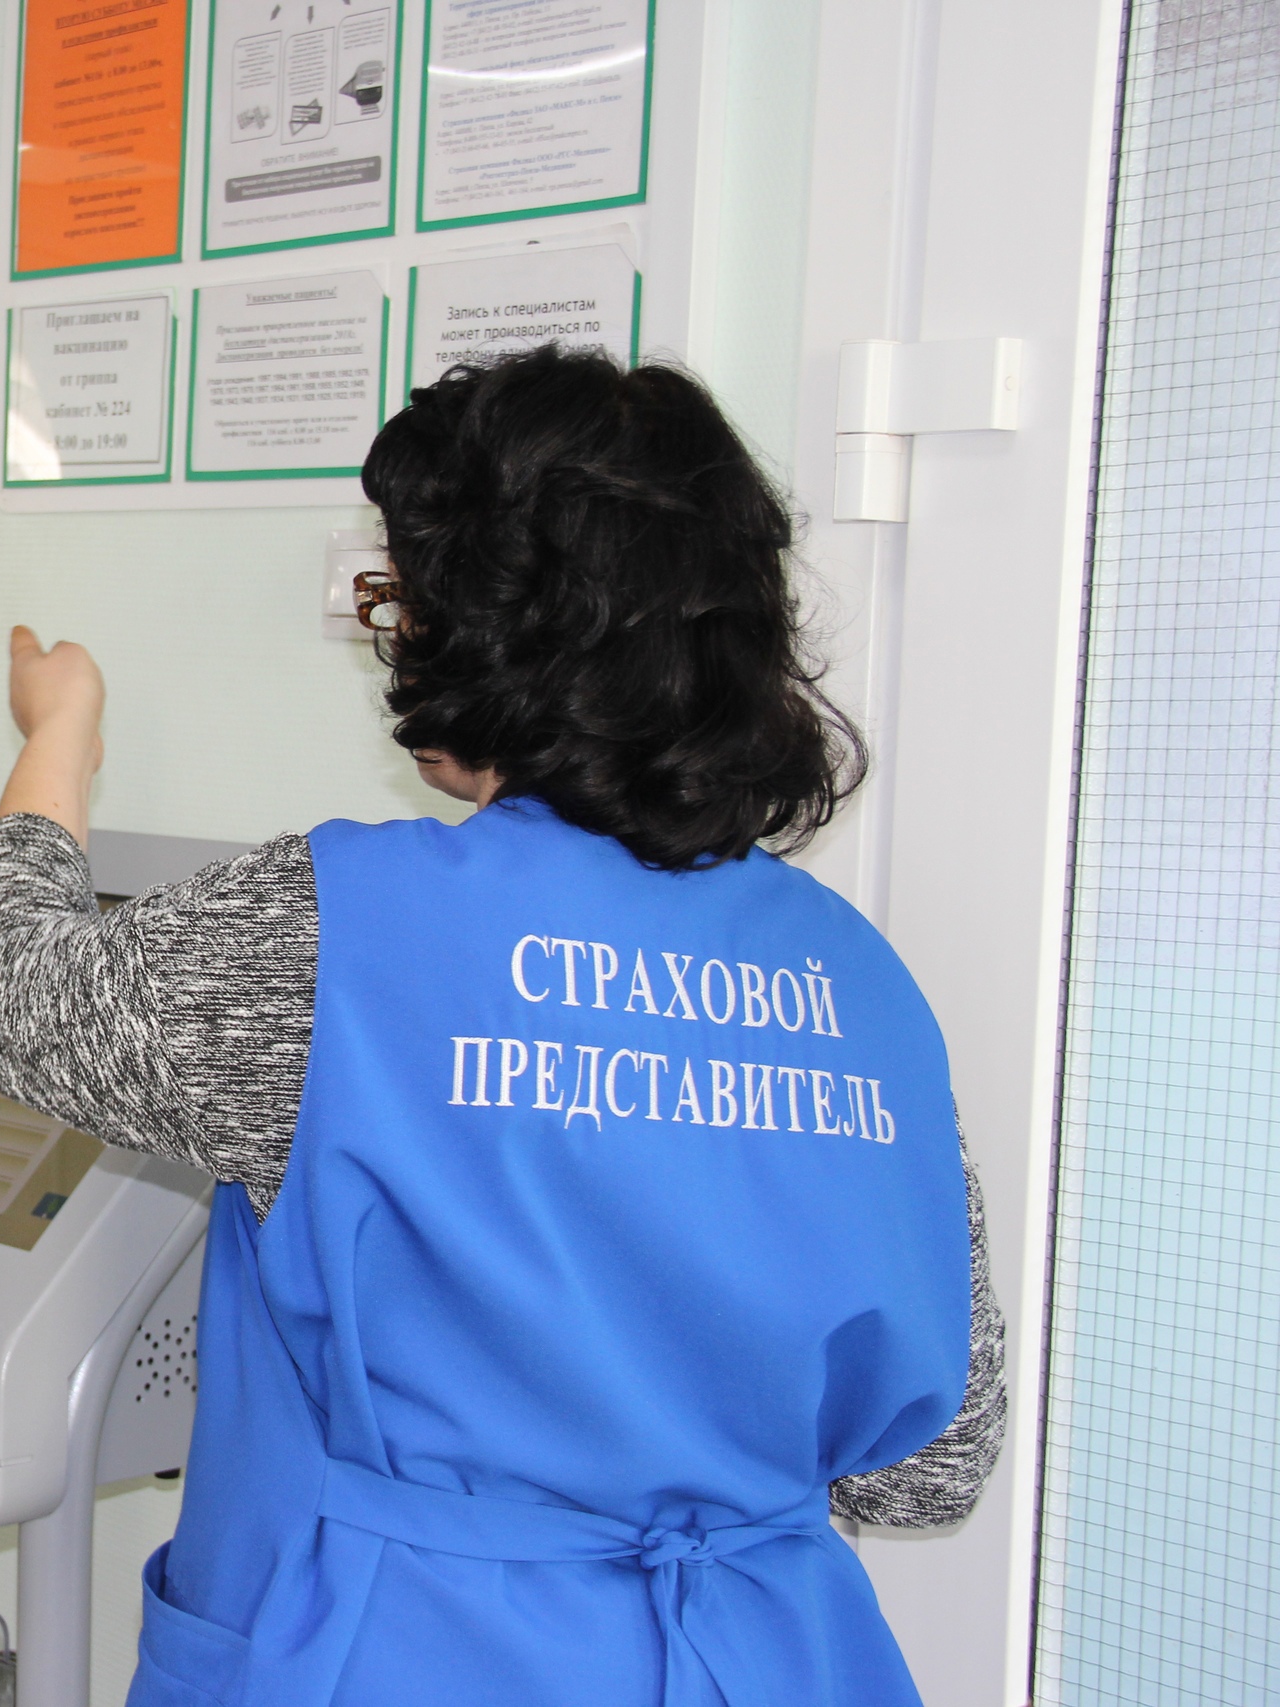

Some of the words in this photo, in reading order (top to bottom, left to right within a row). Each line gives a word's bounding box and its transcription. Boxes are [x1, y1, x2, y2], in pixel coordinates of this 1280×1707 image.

[446, 306, 489, 321] Запись
[493, 306, 501, 317] к
[504, 299, 596, 319] специалистам
[46, 311, 122, 331] Приглашаем
[125, 310, 140, 321] на
[440, 328, 480, 341] может
[484, 321, 579, 340] производиться
[584, 320, 600, 333] по
[54, 339, 129, 355] вакцинацию
[435, 349, 495, 364] телефону
[60, 375, 72, 387] от
[76, 373, 118, 390] гриппа
[45, 403, 92, 419] кабинет
[111, 401, 131, 416] 224
[80, 437, 93, 450] до
[510, 934, 844, 1039] СТРАХОВОЙ
[446, 1035, 897, 1146] ПРЕДСТАВИТЕЛЬ
